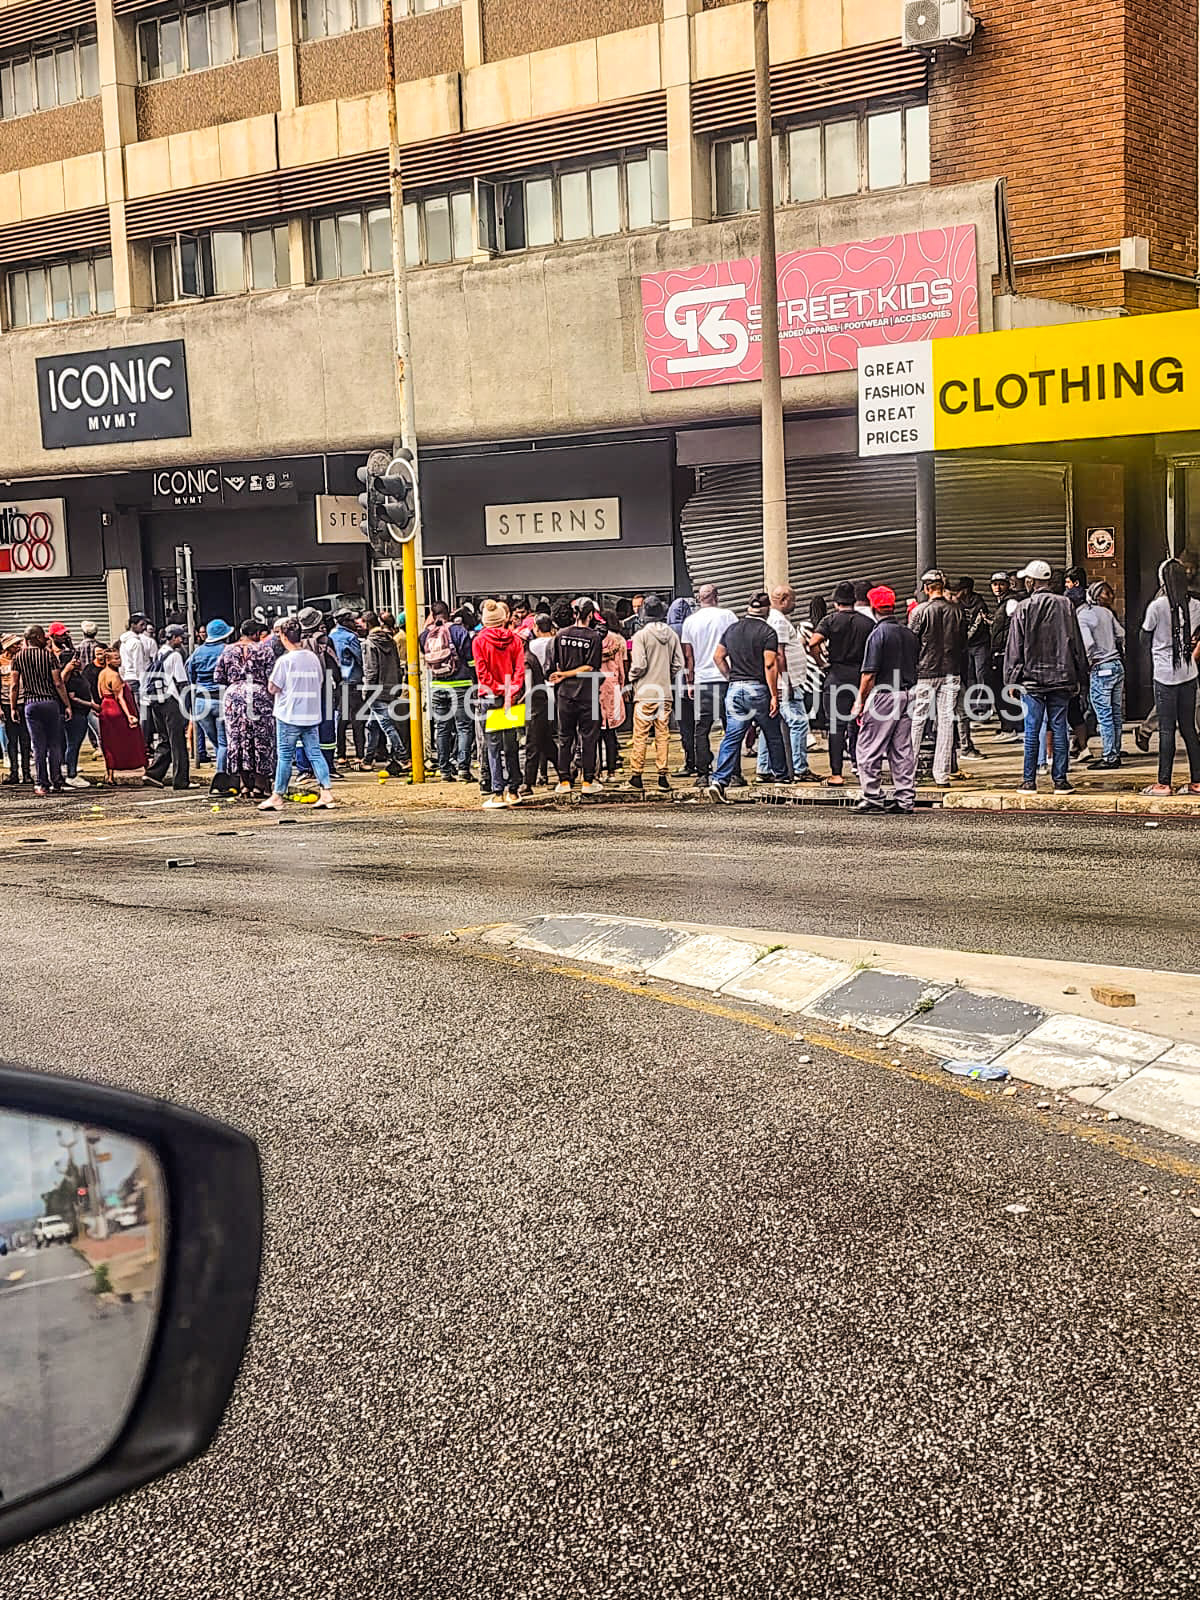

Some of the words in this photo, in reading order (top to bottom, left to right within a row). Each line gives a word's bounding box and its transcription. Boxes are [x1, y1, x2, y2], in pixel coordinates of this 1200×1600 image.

[877, 278, 953, 313] KIDS
[778, 329, 804, 339] ANDED
[805, 323, 841, 336] APPAREL
[844, 317, 889, 331] FOOTWEAR
[894, 309, 952, 325] ACCESSORIES
[864, 359, 914, 377] GREAT
[48, 356, 174, 412] ICONIC
[865, 381, 925, 400] FASHION
[939, 356, 1185, 415] CLOTHING
[88, 412, 137, 431] MVMT
[865, 405, 916, 422] GREAT
[866, 429, 919, 446] PRICES
[153, 469, 219, 496] ICONIC
[174, 495, 202, 505] MVMT
[499, 508, 605, 535] STERNS
